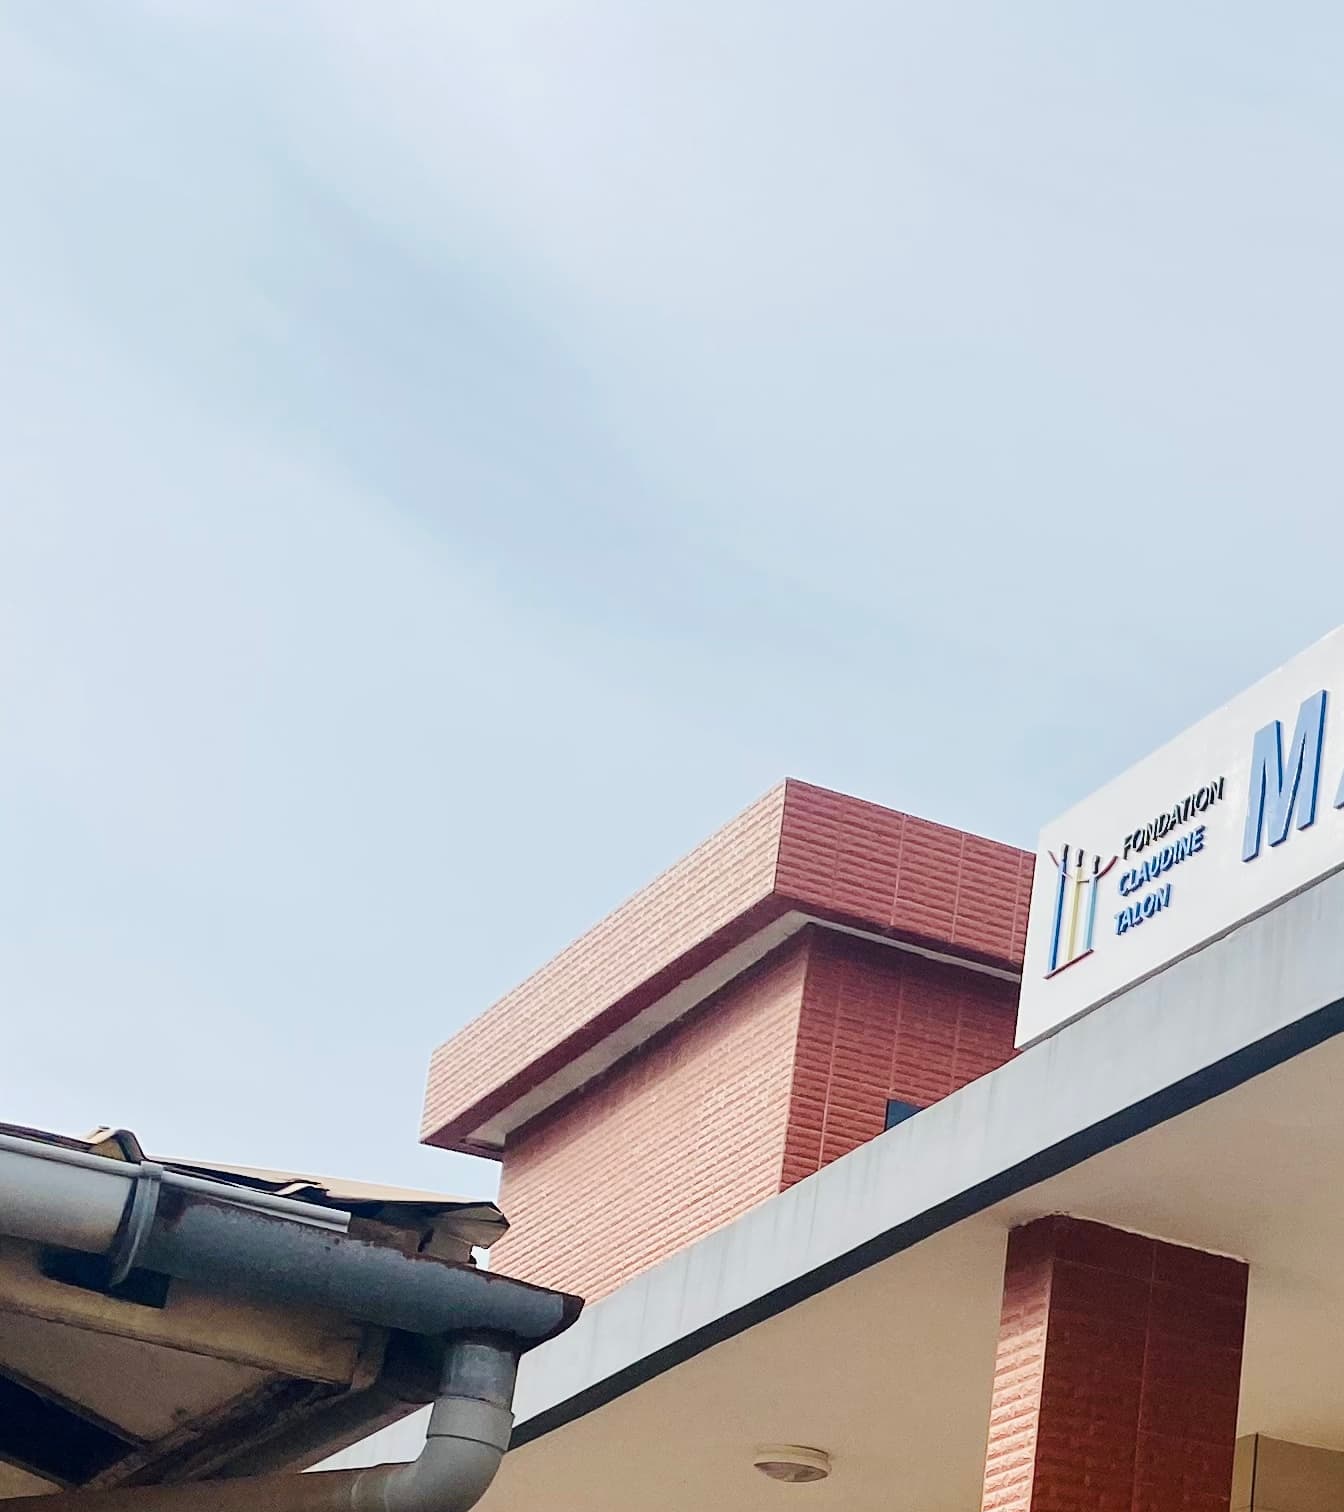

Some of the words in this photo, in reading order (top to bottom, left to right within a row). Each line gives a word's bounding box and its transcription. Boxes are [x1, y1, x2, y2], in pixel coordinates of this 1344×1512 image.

[1123, 776, 1225, 860] FONDATION
[1118, 825, 1206, 896] CLAUDINE
[1114, 884, 1172, 935] TALON
